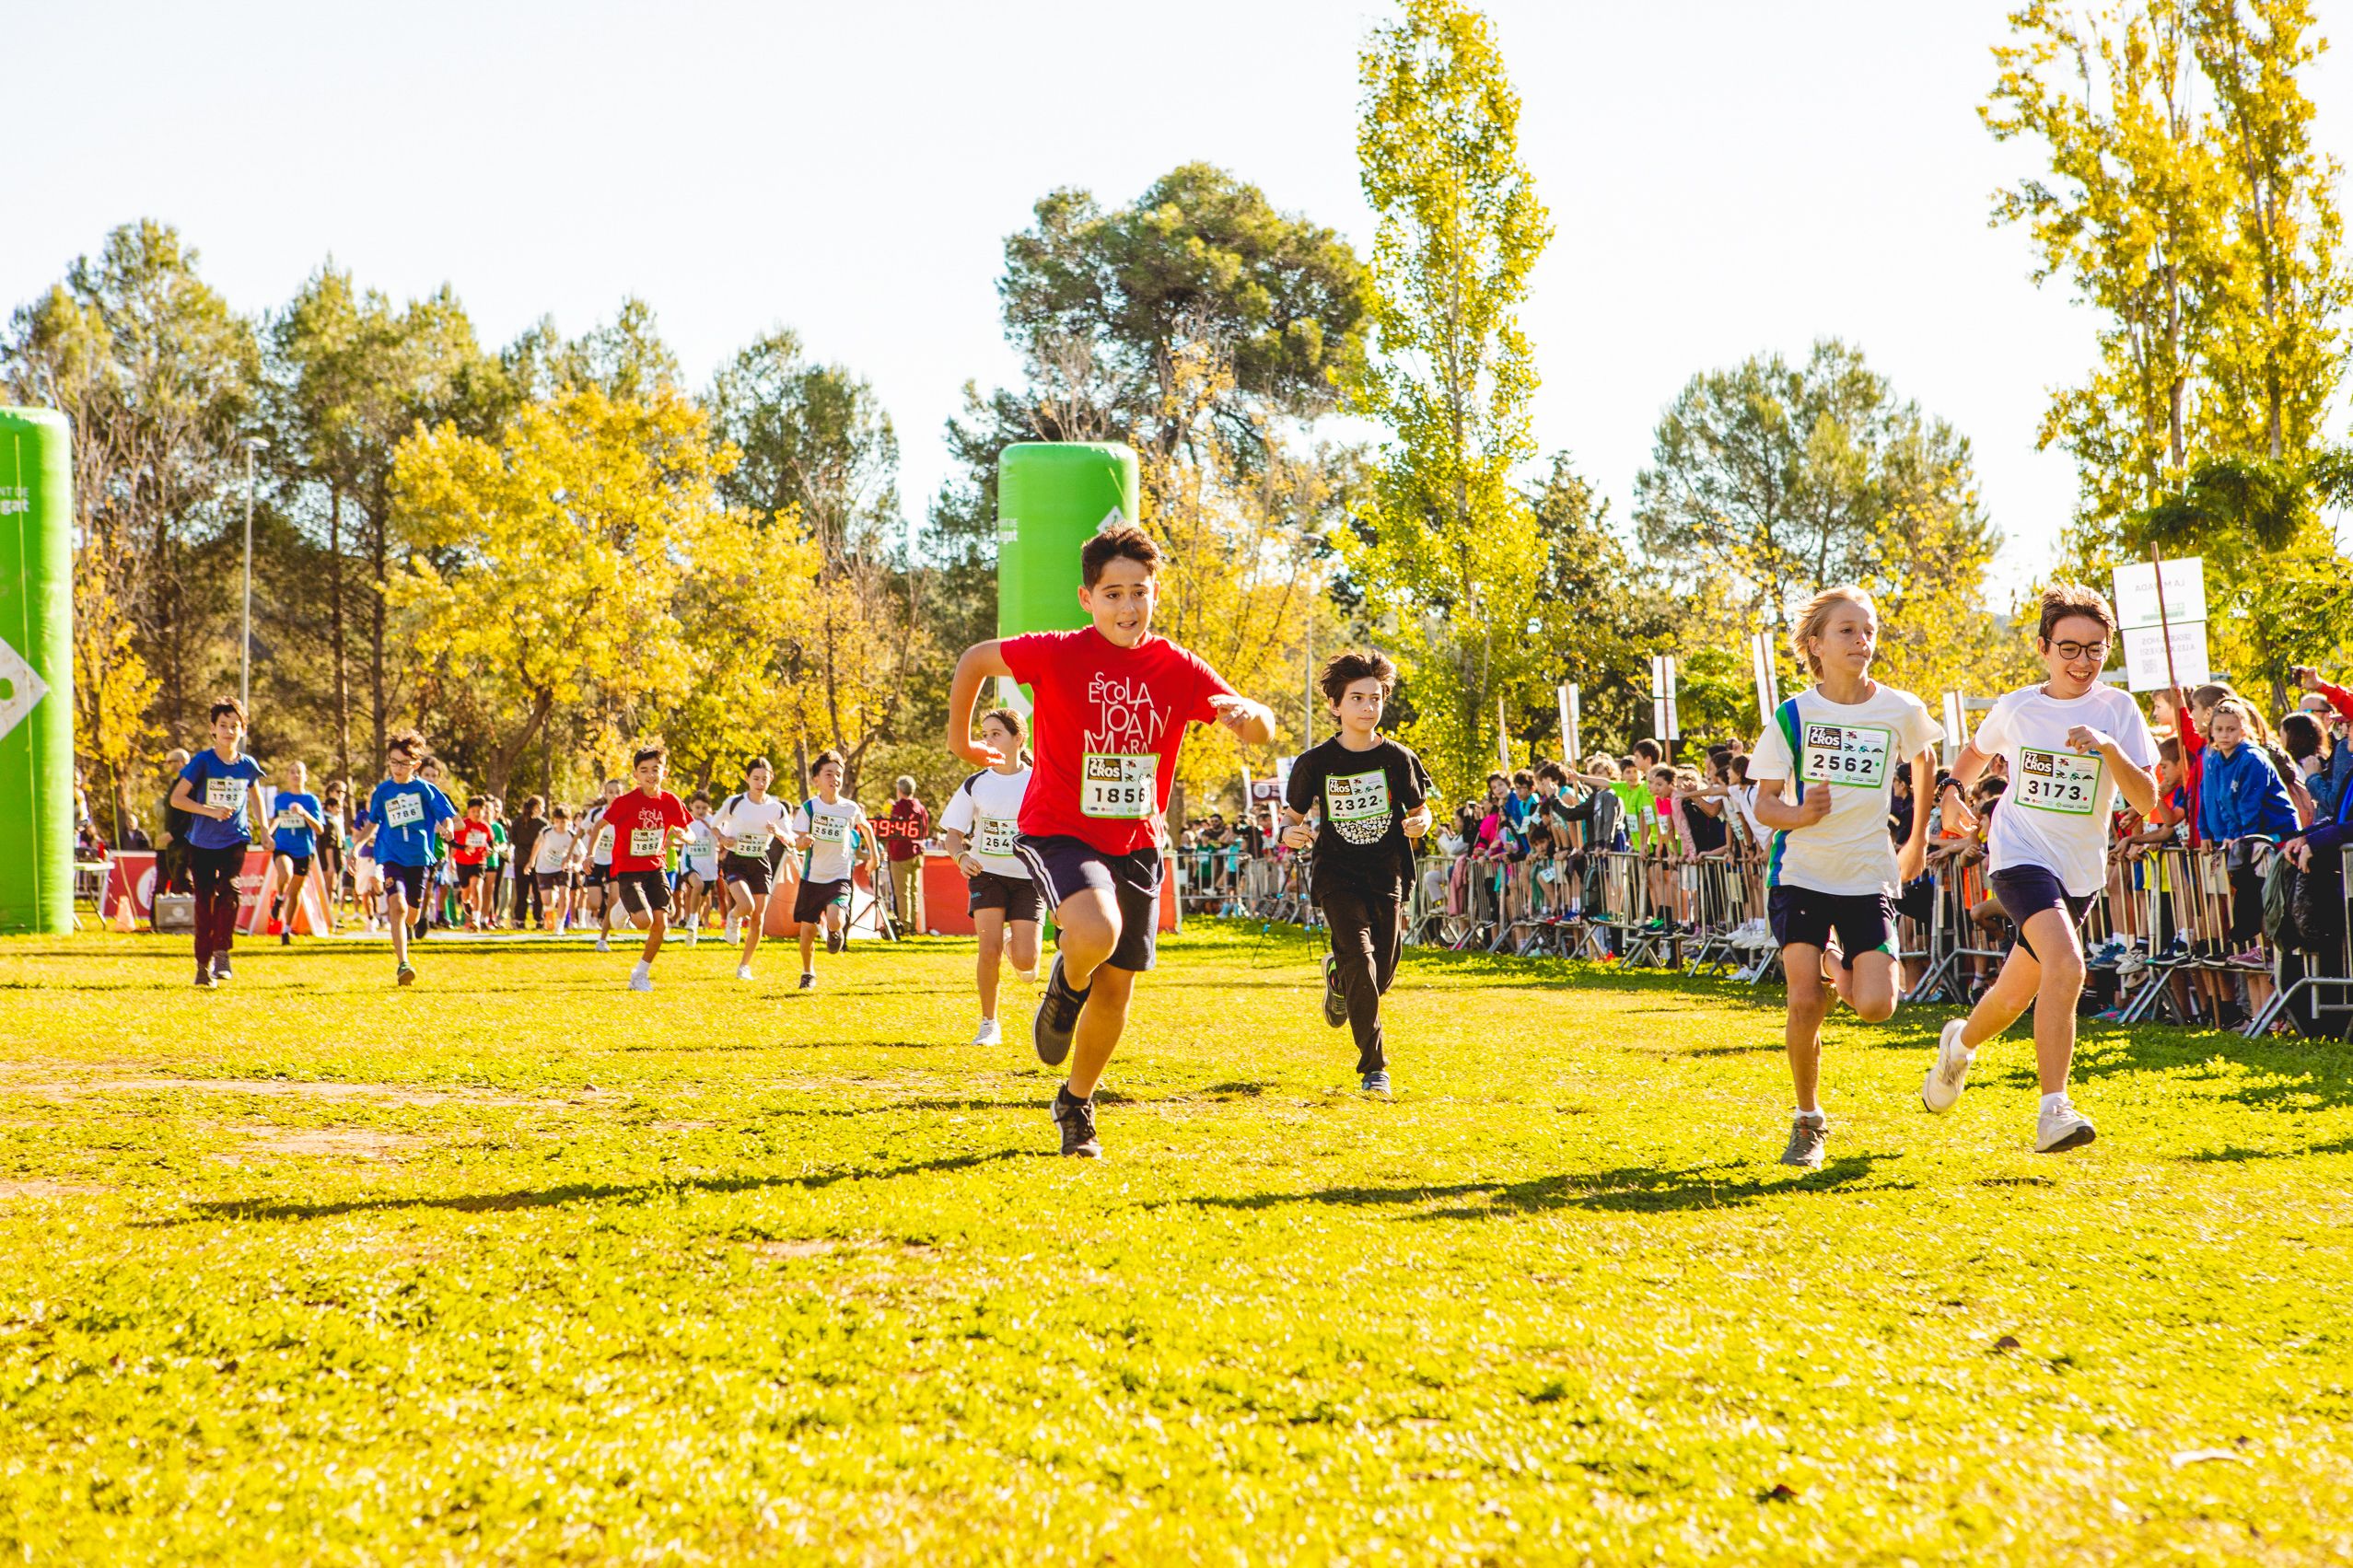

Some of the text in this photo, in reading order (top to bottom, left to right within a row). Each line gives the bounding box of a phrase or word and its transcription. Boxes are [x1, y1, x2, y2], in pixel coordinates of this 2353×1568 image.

[1089, 671, 1155, 711] ESCOLA
[1092, 701, 1171, 745] JOAN
[1810, 734, 1840, 747] CROS
[1812, 754, 1872, 774] 2562
[2024, 760, 2052, 773] CROS
[1089, 766, 1121, 778] CROS
[1329, 785, 1351, 794] CROS
[2028, 780, 2081, 801] 3173
[213, 794, 239, 802] 1793
[1334, 795, 1379, 811] 2322
[391, 808, 417, 820] 1786
[815, 826, 840, 837] 2566
[985, 836, 1010, 848] 264
